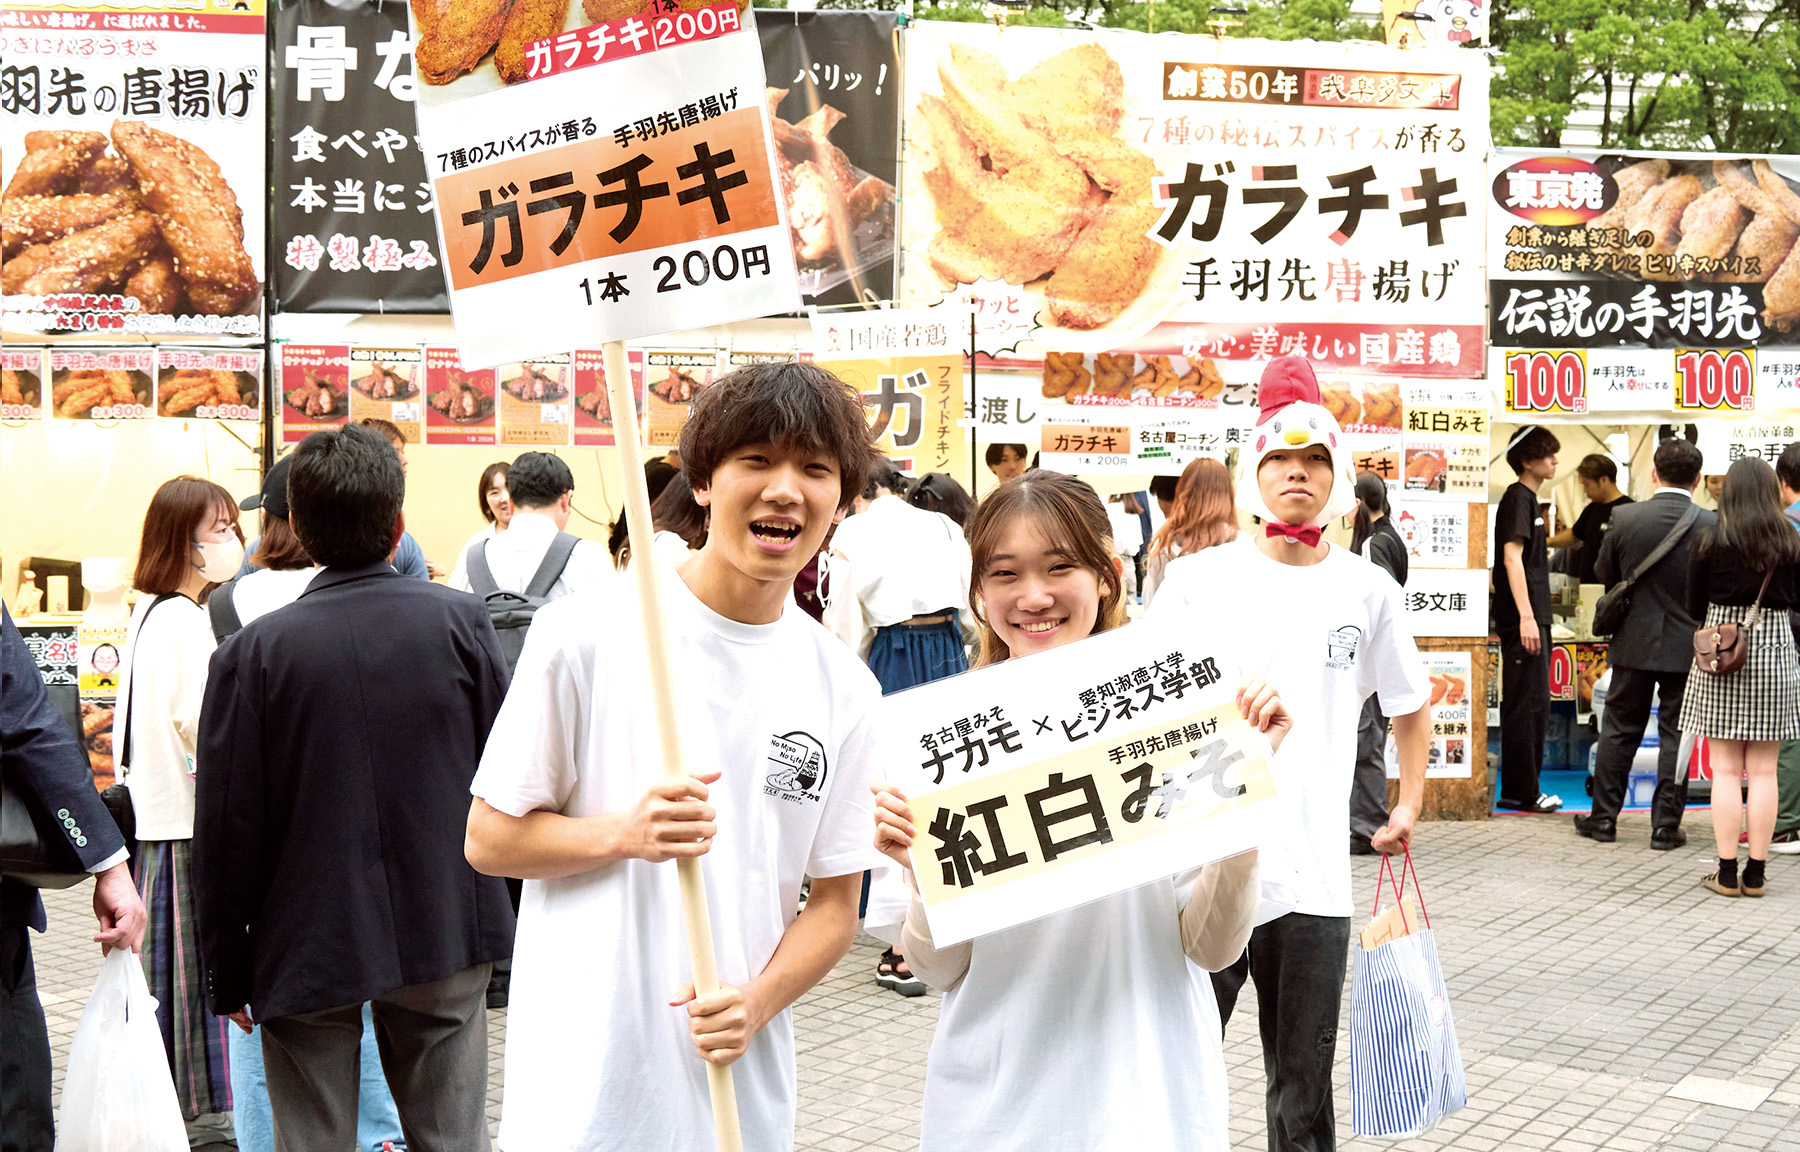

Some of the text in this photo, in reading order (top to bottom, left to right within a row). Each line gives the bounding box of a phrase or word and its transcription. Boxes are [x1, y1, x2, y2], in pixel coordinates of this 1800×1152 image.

[525, 8, 740, 79] ガラチキ 200円
[1167, 65, 1299, 102] 創業50年
[289, 125, 425, 164] 食べや
[437, 87, 738, 172] 7種のスパイスが香る 手羽先唐揚げ
[1138, 114, 1467, 153] 7種の秘伝スパイスが香る
[462, 141, 749, 275] ガラチキ
[1157, 160, 1467, 247] ガラチキ
[1506, 170, 1604, 210] 東京発
[285, 233, 437, 272] 特製極み
[1505, 225, 1654, 249] 創業から継ぎ足しの
[579, 271, 631, 306] 1本
[652, 244, 771, 294] 200円
[1182, 257, 1460, 303] 手羽先唐揚げ
[1499, 284, 1762, 341] 伝説の手羽先
[53, 355, 152, 368] 手羽先の唐揚げ
[160, 353, 259, 369] 手羽先の唐揚げ
[1593, 366, 1645, 377] #手羽先は
[1608, 379, 1669, 391] 人を幸せにする
[857, 372, 928, 470] ガ
[935, 366, 952, 469] フライドチキン
[964, 396, 1037, 424] 渡し
[1409, 410, 1485, 433] 紅白みそ
[1054, 434, 1117, 452] ガラチキ
[1140, 430, 1220, 445] 名古屋コーチン
[1098, 456, 1128, 467] 200円
[1353, 457, 1394, 478] チキ
[1079, 651, 1186, 709] 愛知淑徳大学
[919, 705, 1005, 751] 名古屋みそ
[921, 720, 1023, 785] ナカモ
[1061, 657, 1222, 742] ビジネス学部
[1108, 716, 1218, 765] 手羽先唐揚げ
[801, 790, 820, 802] ナカモ
[928, 739, 1247, 889] 紅白みそ
